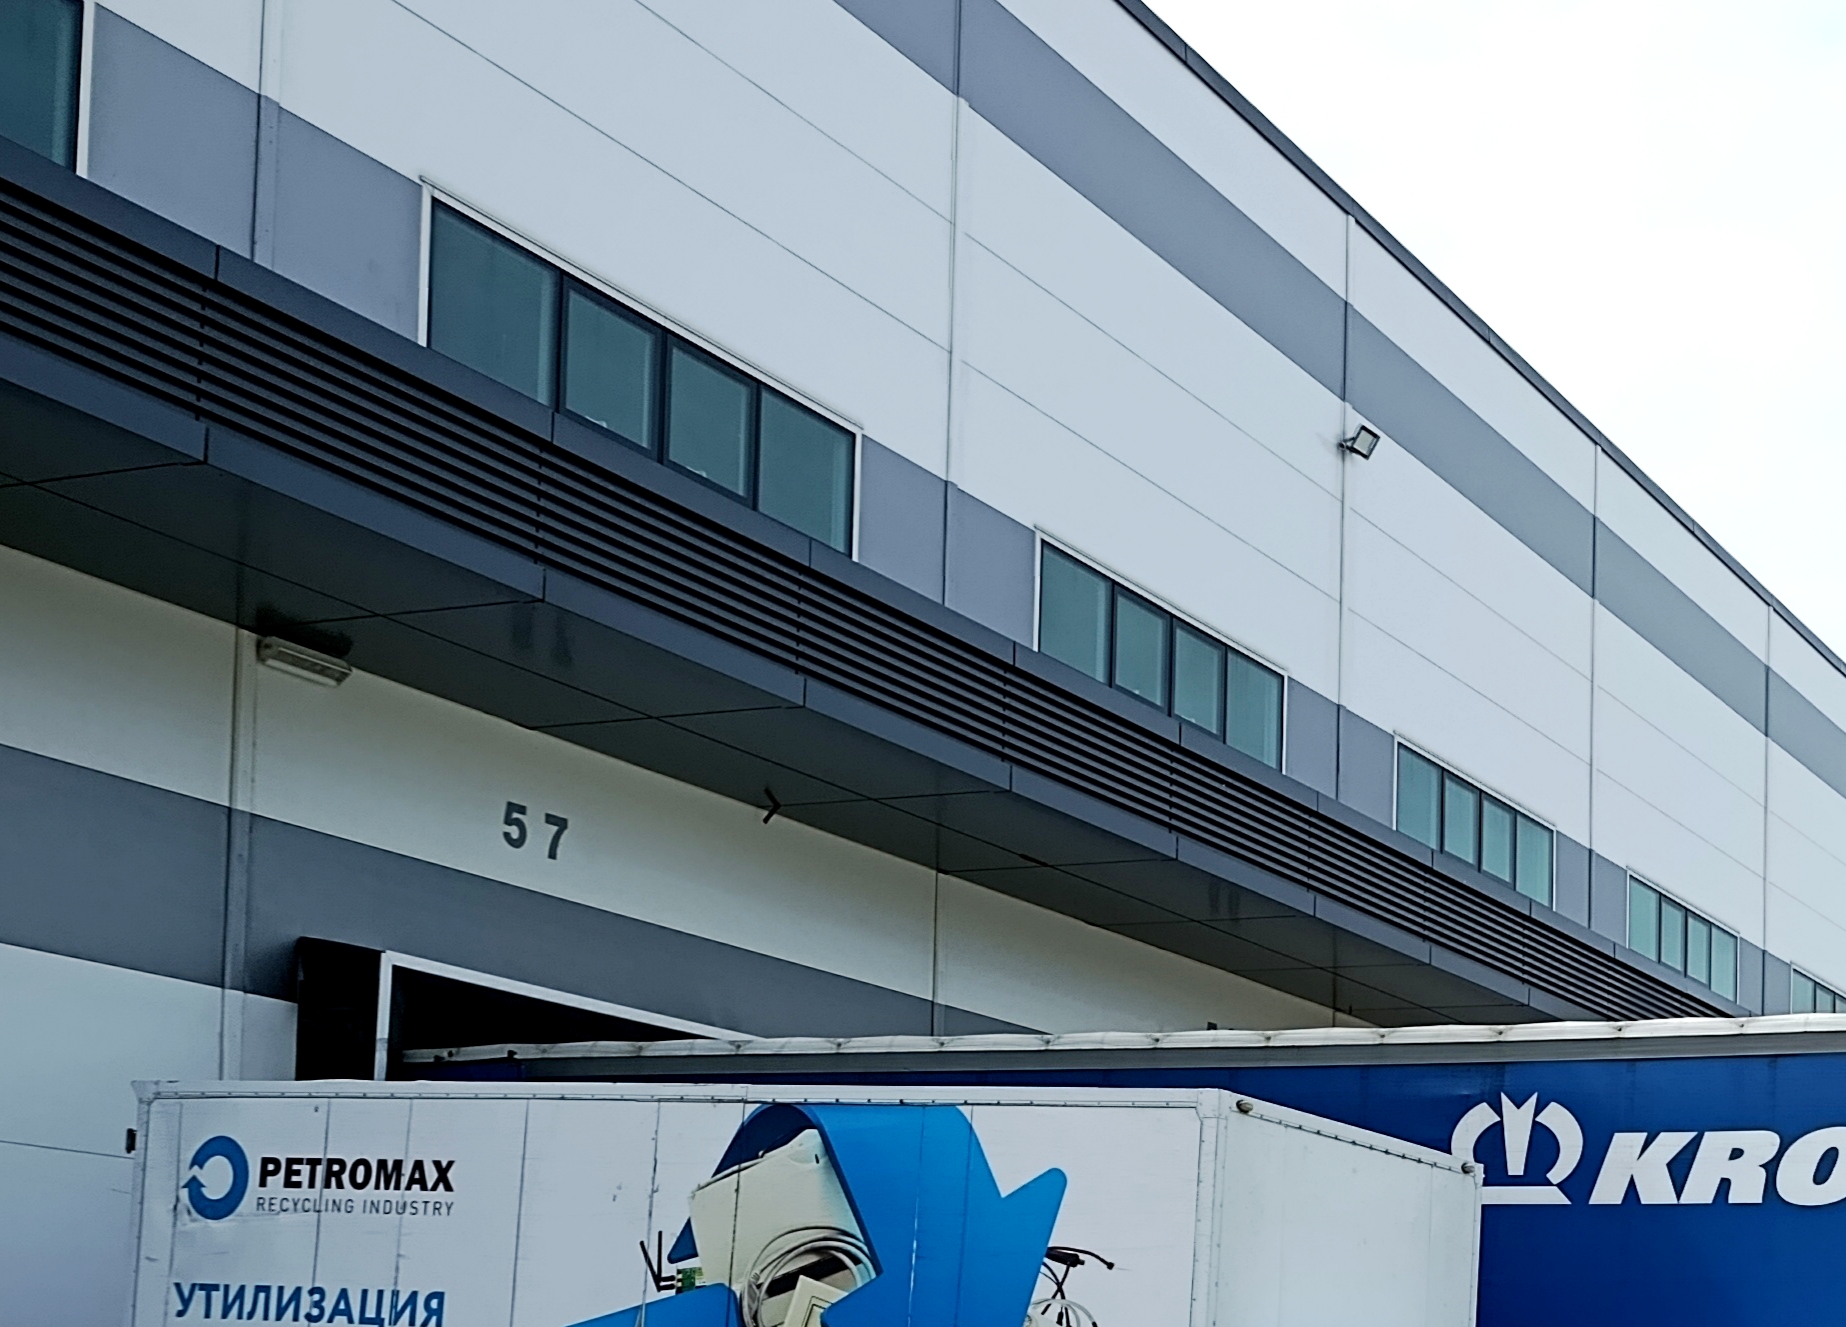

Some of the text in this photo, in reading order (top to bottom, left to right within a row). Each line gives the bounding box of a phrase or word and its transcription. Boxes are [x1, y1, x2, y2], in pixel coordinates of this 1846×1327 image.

[258, 1156, 455, 1192] PETROMAX
[256, 1197, 454, 1217] RECYCLING INDUSTRY
